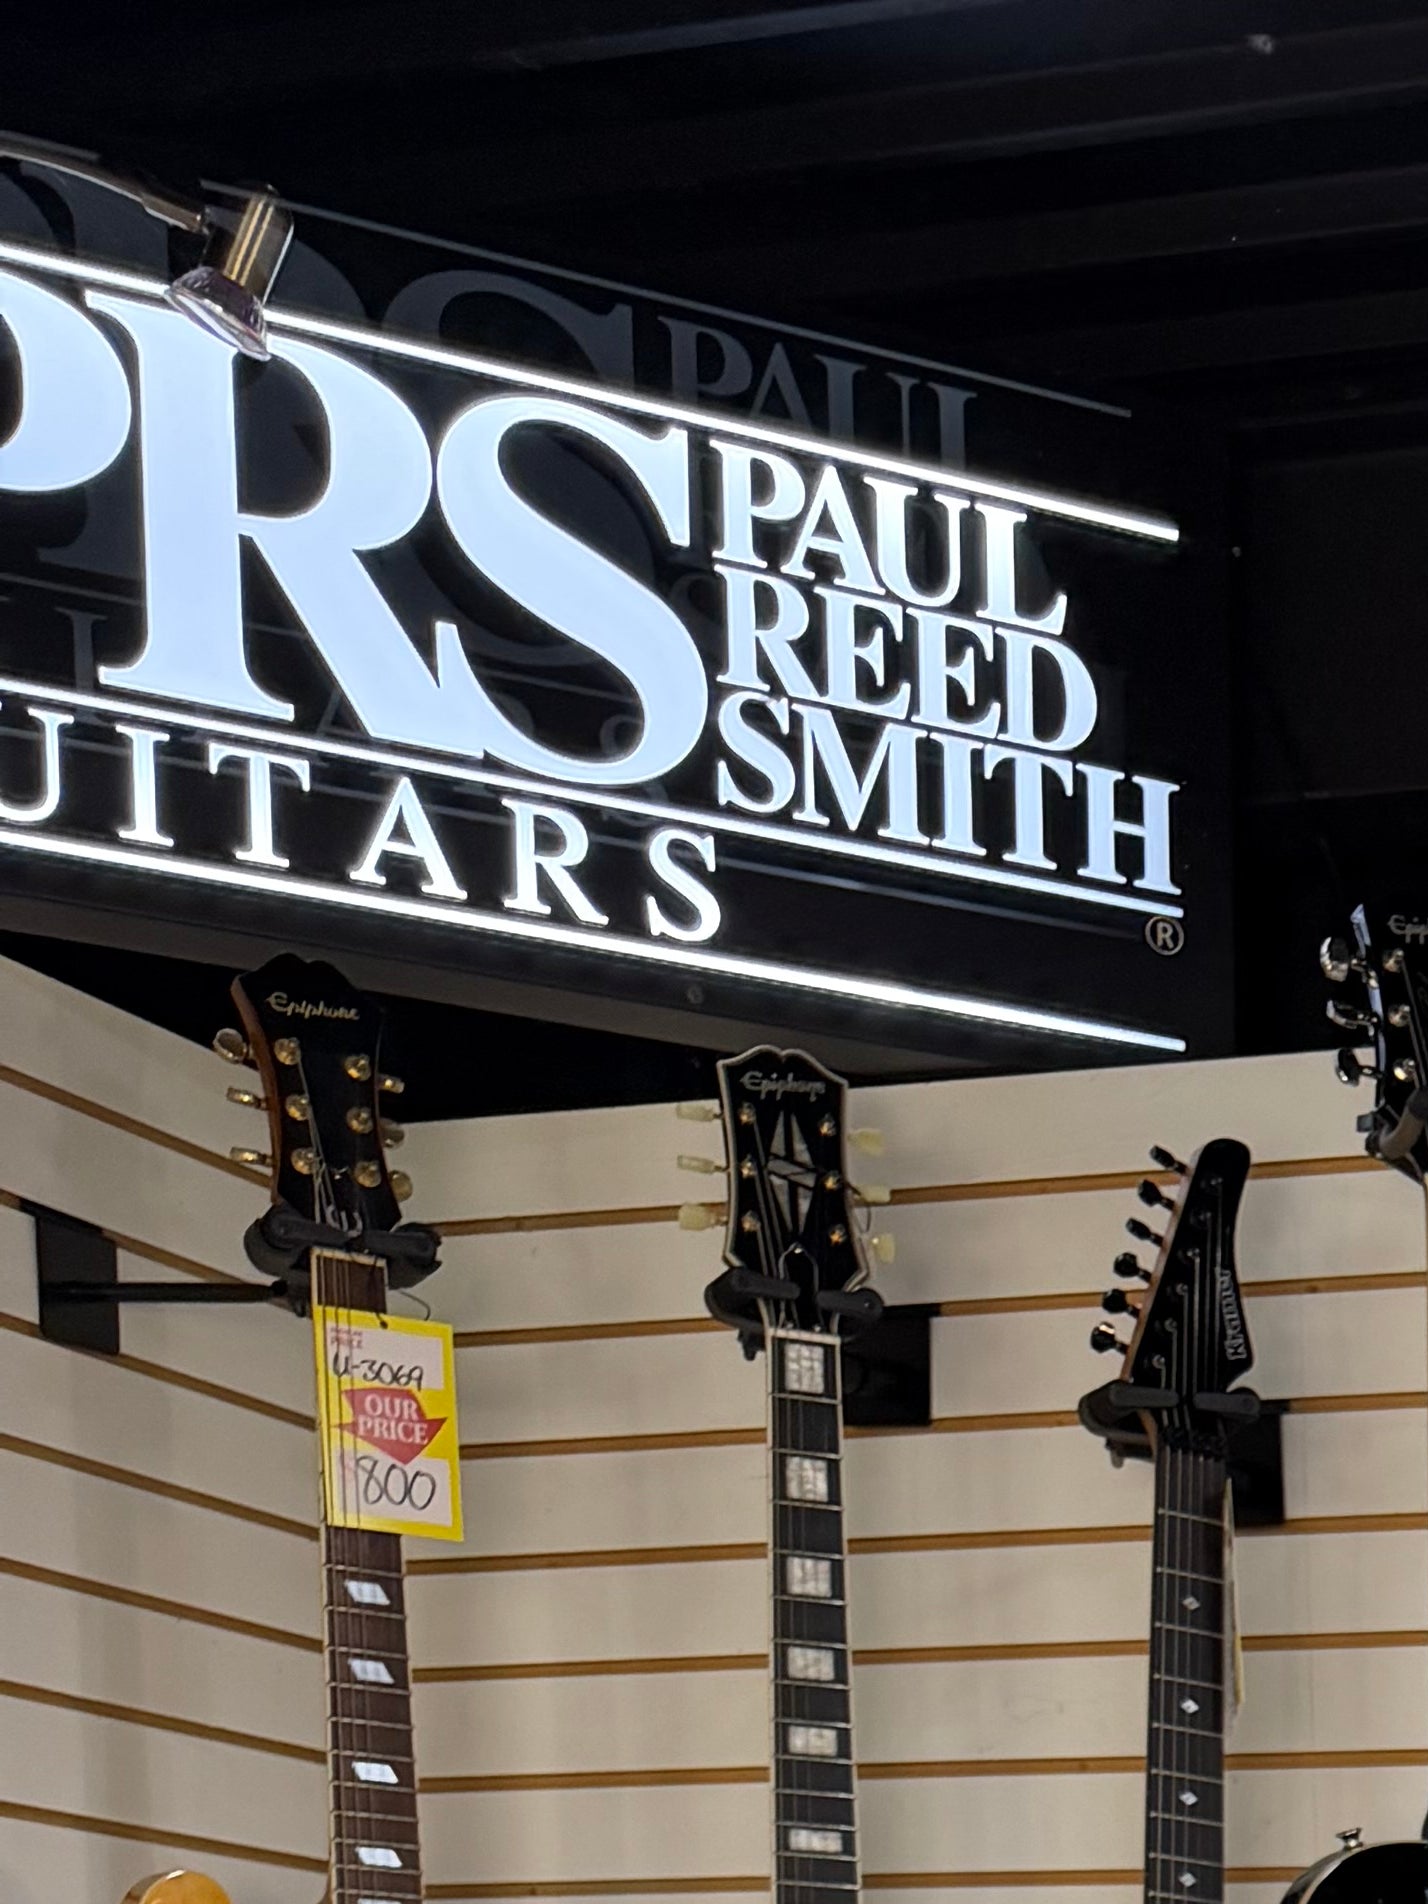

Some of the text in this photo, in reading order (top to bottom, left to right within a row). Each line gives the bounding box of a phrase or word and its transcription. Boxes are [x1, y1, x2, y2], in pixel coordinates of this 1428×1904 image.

[709, 437, 1068, 636] PAUL
[717, 563, 1100, 757] REED
[717, 693, 1188, 898] SMITH
[265, 990, 361, 1021] Epiphone
[357, 1414, 429, 1445] PRICE
[363, 1393, 419, 1421] OUR
